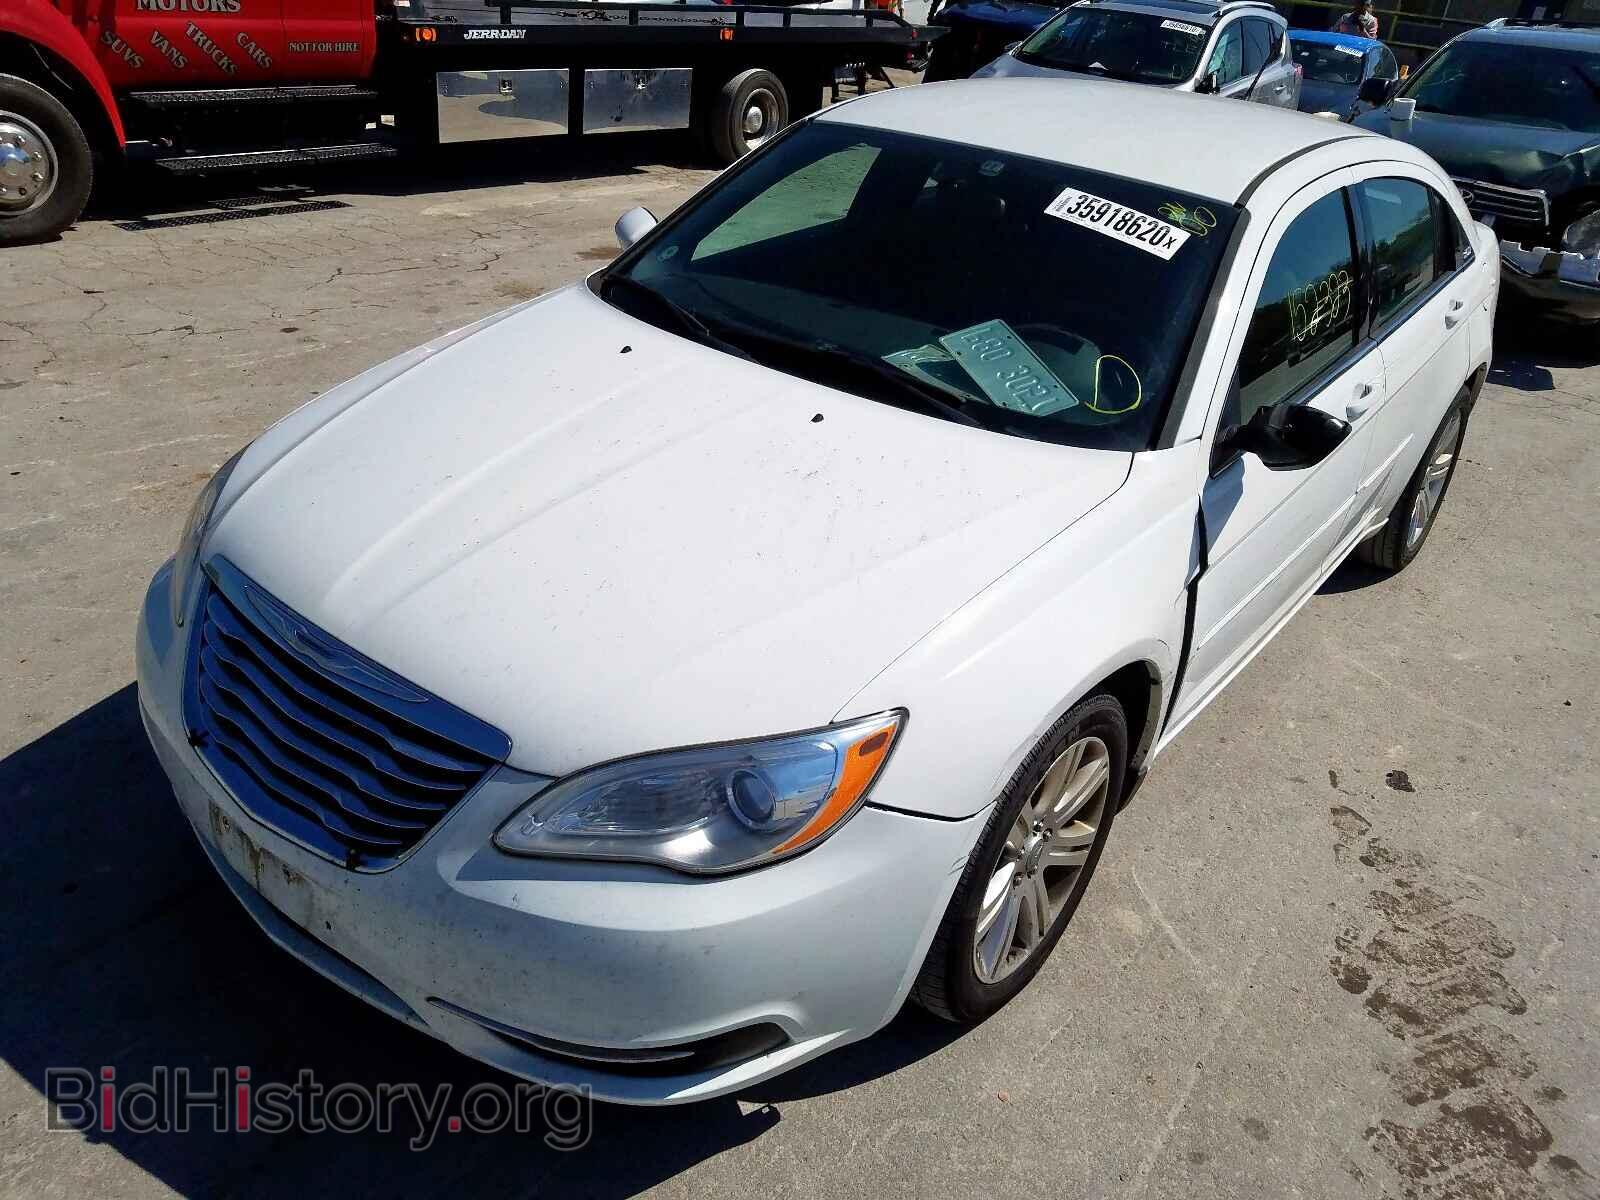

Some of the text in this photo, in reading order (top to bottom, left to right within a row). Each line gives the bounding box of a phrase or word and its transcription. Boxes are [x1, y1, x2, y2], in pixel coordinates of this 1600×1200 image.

[137, 0, 241, 12] MOTORS
[151, 30, 188, 68] VANS
[185, 22, 238, 75] TRUCKS
[237, 32, 272, 69] CARS
[289, 42, 360, 52] NOT FOR HIRE
